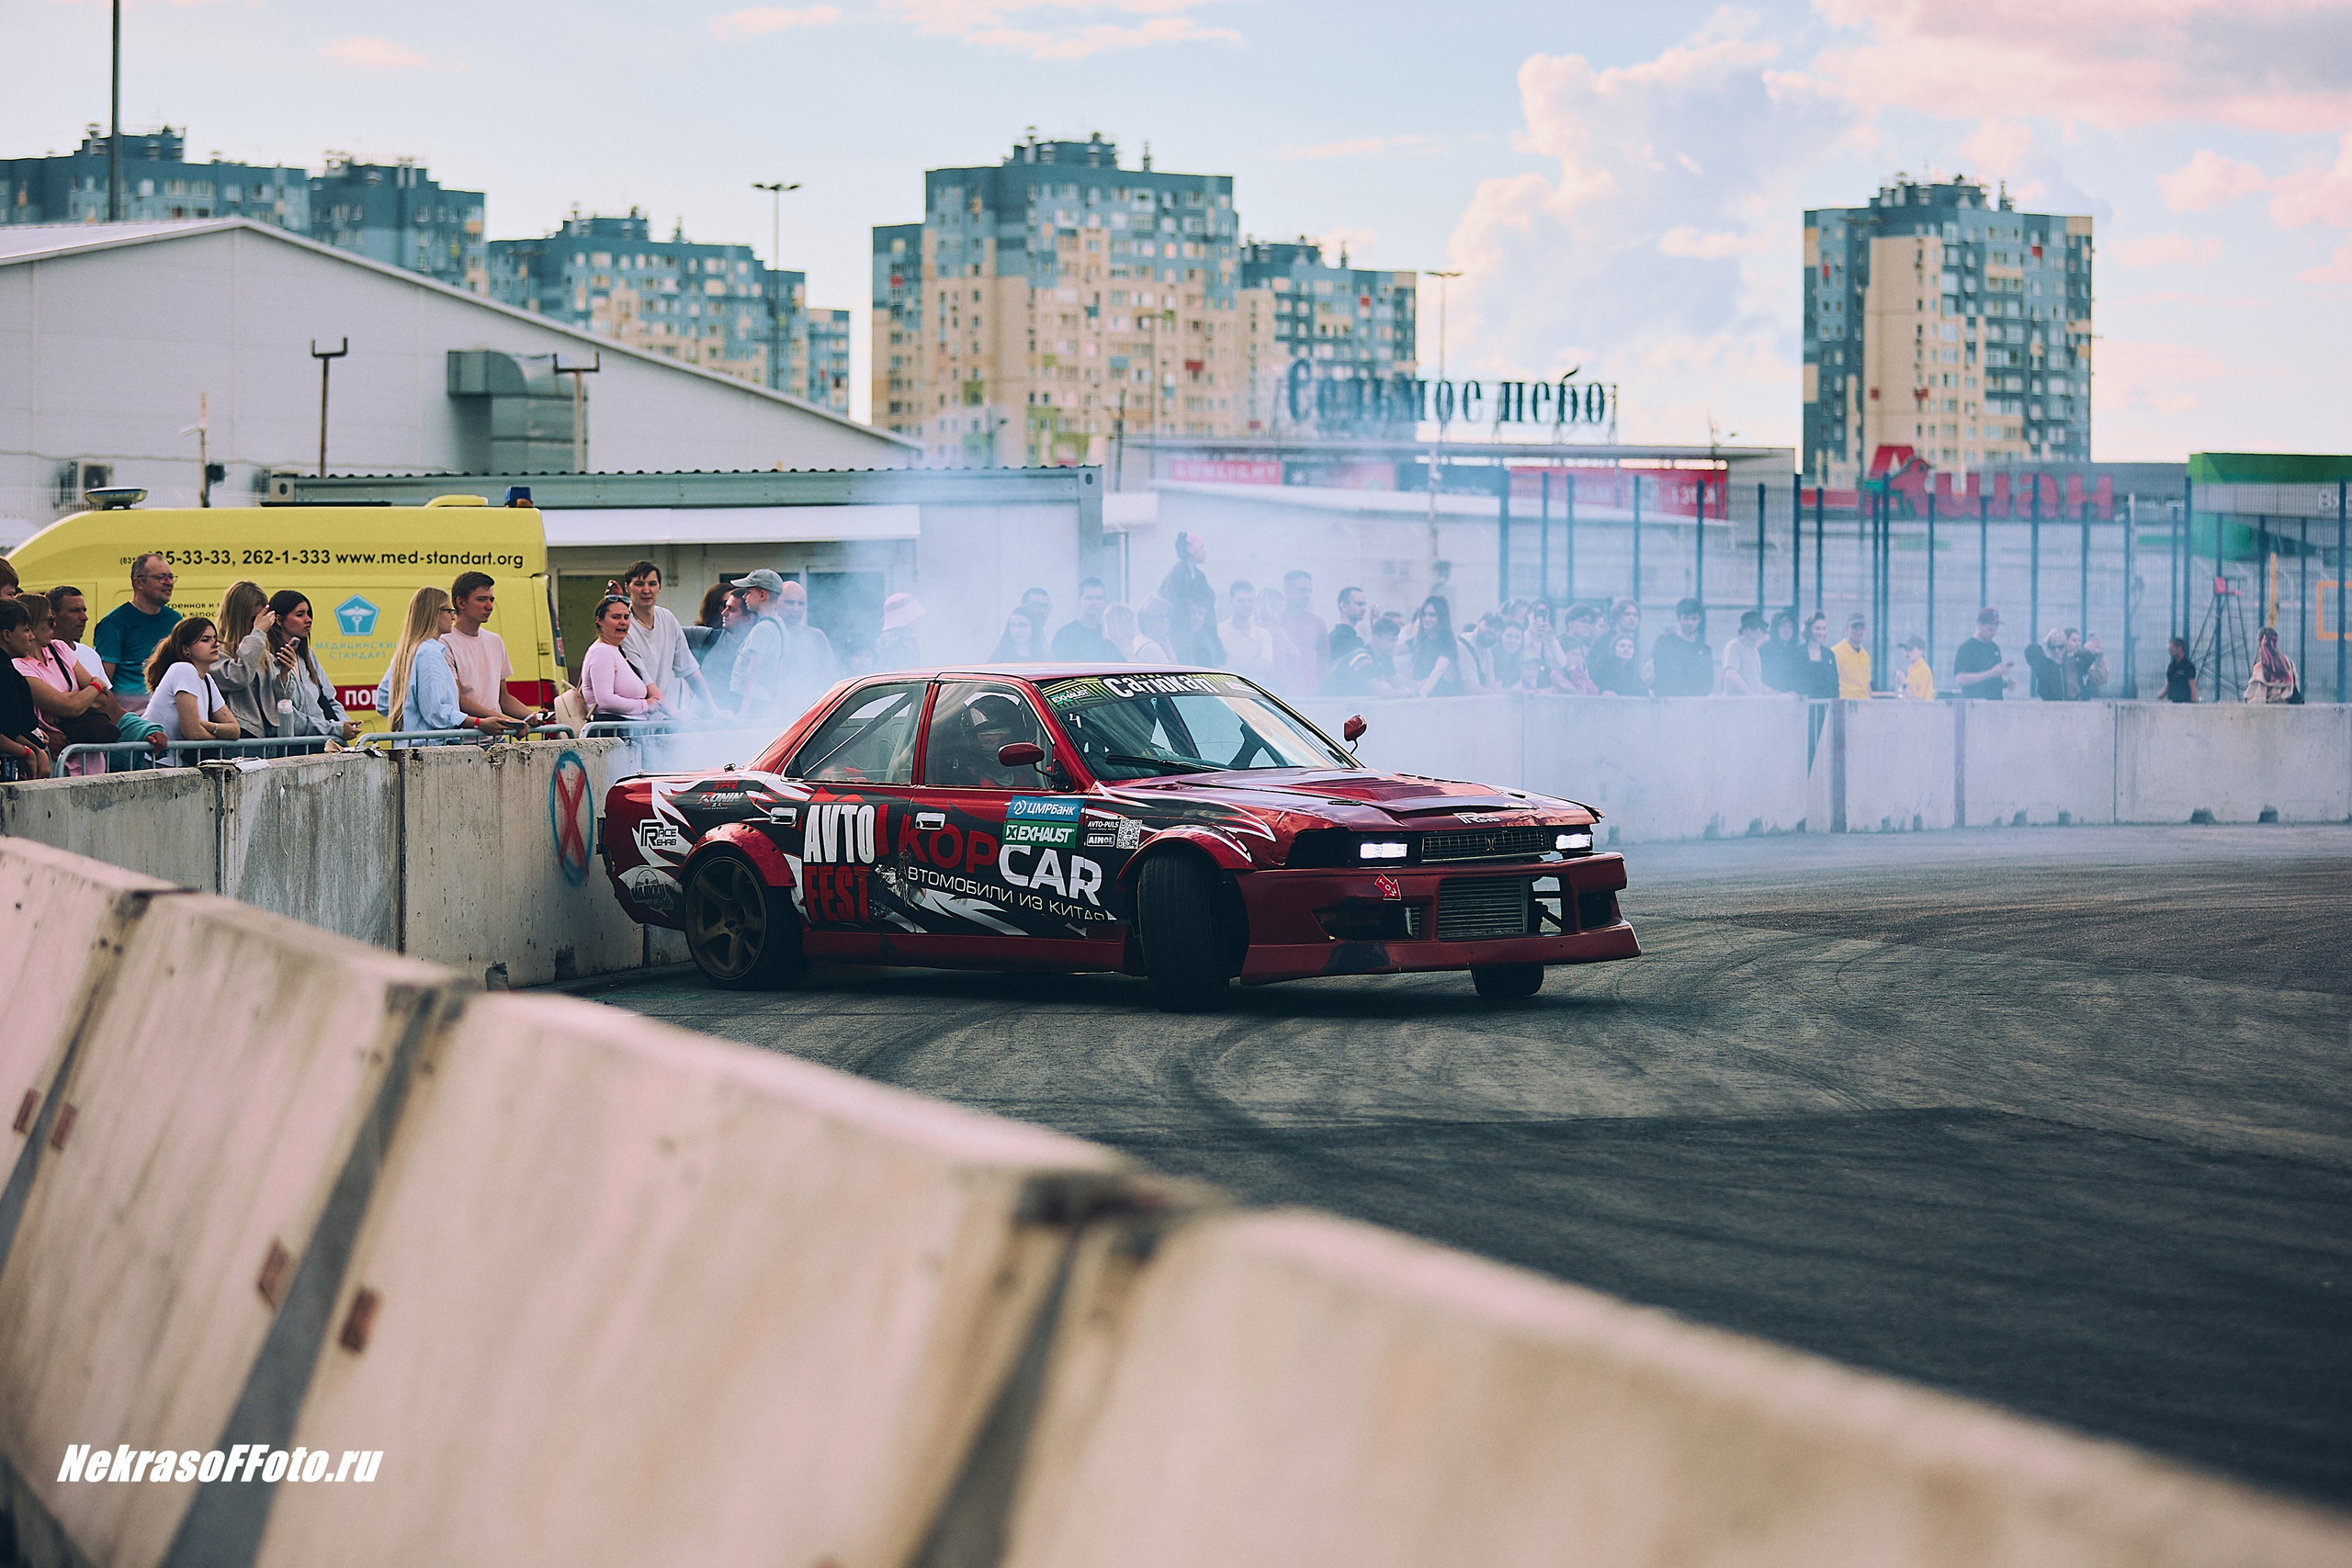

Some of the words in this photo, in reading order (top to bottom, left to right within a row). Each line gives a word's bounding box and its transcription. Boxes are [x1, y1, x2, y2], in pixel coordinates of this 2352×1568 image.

[1500, 366, 1606, 423] небо
[148, 550, 235, 567] 5-33-33,
[243, 549, 330, 564] 262-1-333
[336, 550, 524, 569] www.med-standart.org
[167, 604, 206, 612] тренная
[330, 651, 386, 660] СТАНДАРТ
[1051, 689, 1090, 704] EXHAUST
[697, 792, 744, 805] RONIN
[1027, 803, 1076, 816] ЦМРБанк
[1087, 820, 1119, 829] AVTO-PULS
[803, 804, 875, 863] AVTO
[1017, 826, 1073, 843] EXHAUST
[803, 865, 871, 924] FEST
[907, 866, 1013, 905] ВТОМОБИЛИ
[1019, 892, 1043, 910] ИЗ
[1379, 878, 1397, 897] TOW
